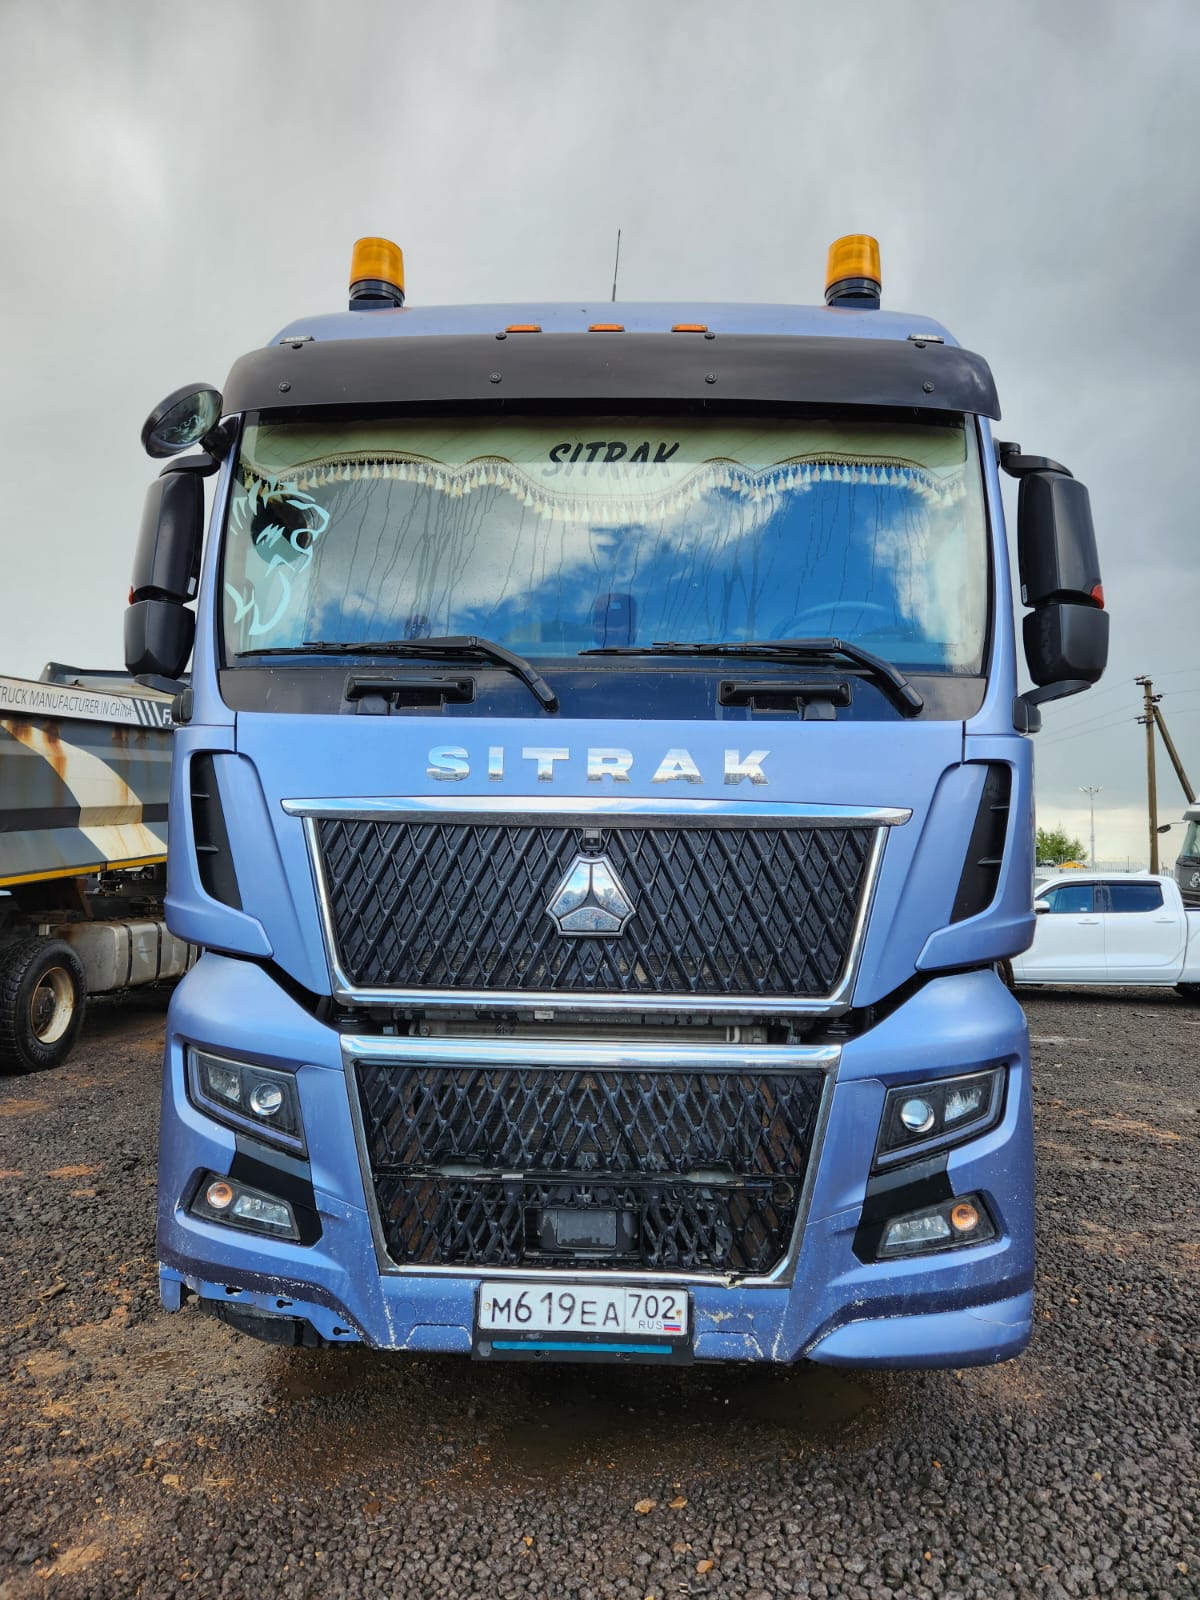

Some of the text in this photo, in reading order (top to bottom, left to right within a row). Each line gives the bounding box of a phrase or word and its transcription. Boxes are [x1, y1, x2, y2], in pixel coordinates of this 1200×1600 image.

[541, 441, 680, 480] SITRAK
[30, 690, 99, 715] MANUFACTURER
[100, 700, 110, 715] IN
[110, 702, 133, 719] CHINA
[426, 745, 772, 786] SITRAK
[491, 1290, 676, 1327] M619EA 702
[638, 1320, 663, 1330] RUS
